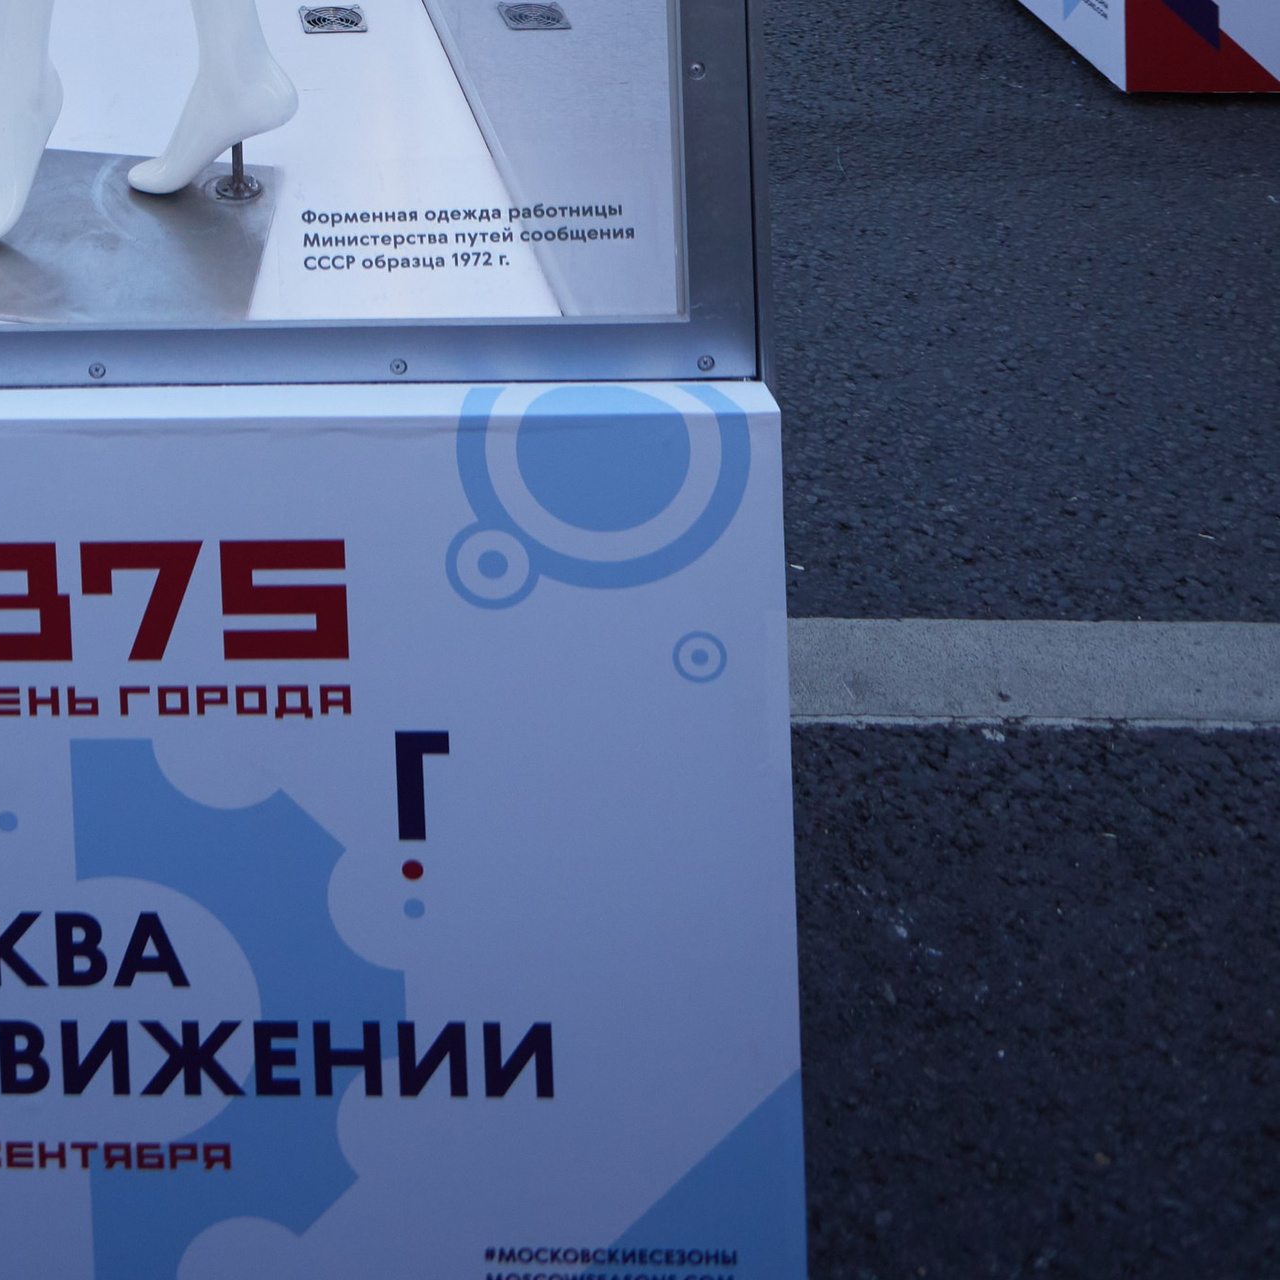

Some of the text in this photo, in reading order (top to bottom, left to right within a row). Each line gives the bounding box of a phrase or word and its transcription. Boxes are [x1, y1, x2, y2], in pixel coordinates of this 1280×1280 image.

[301, 202, 623, 228] Форменная одежда работницы
[303, 225, 635, 253] Министерства путей сообщения
[303, 251, 511, 272] СССР образца 1972 г.
[118, 682, 354, 720] ГОРОДА
[484, 1246, 738, 1265] #МОСКОВСКИЕСЕЗОНЫ
